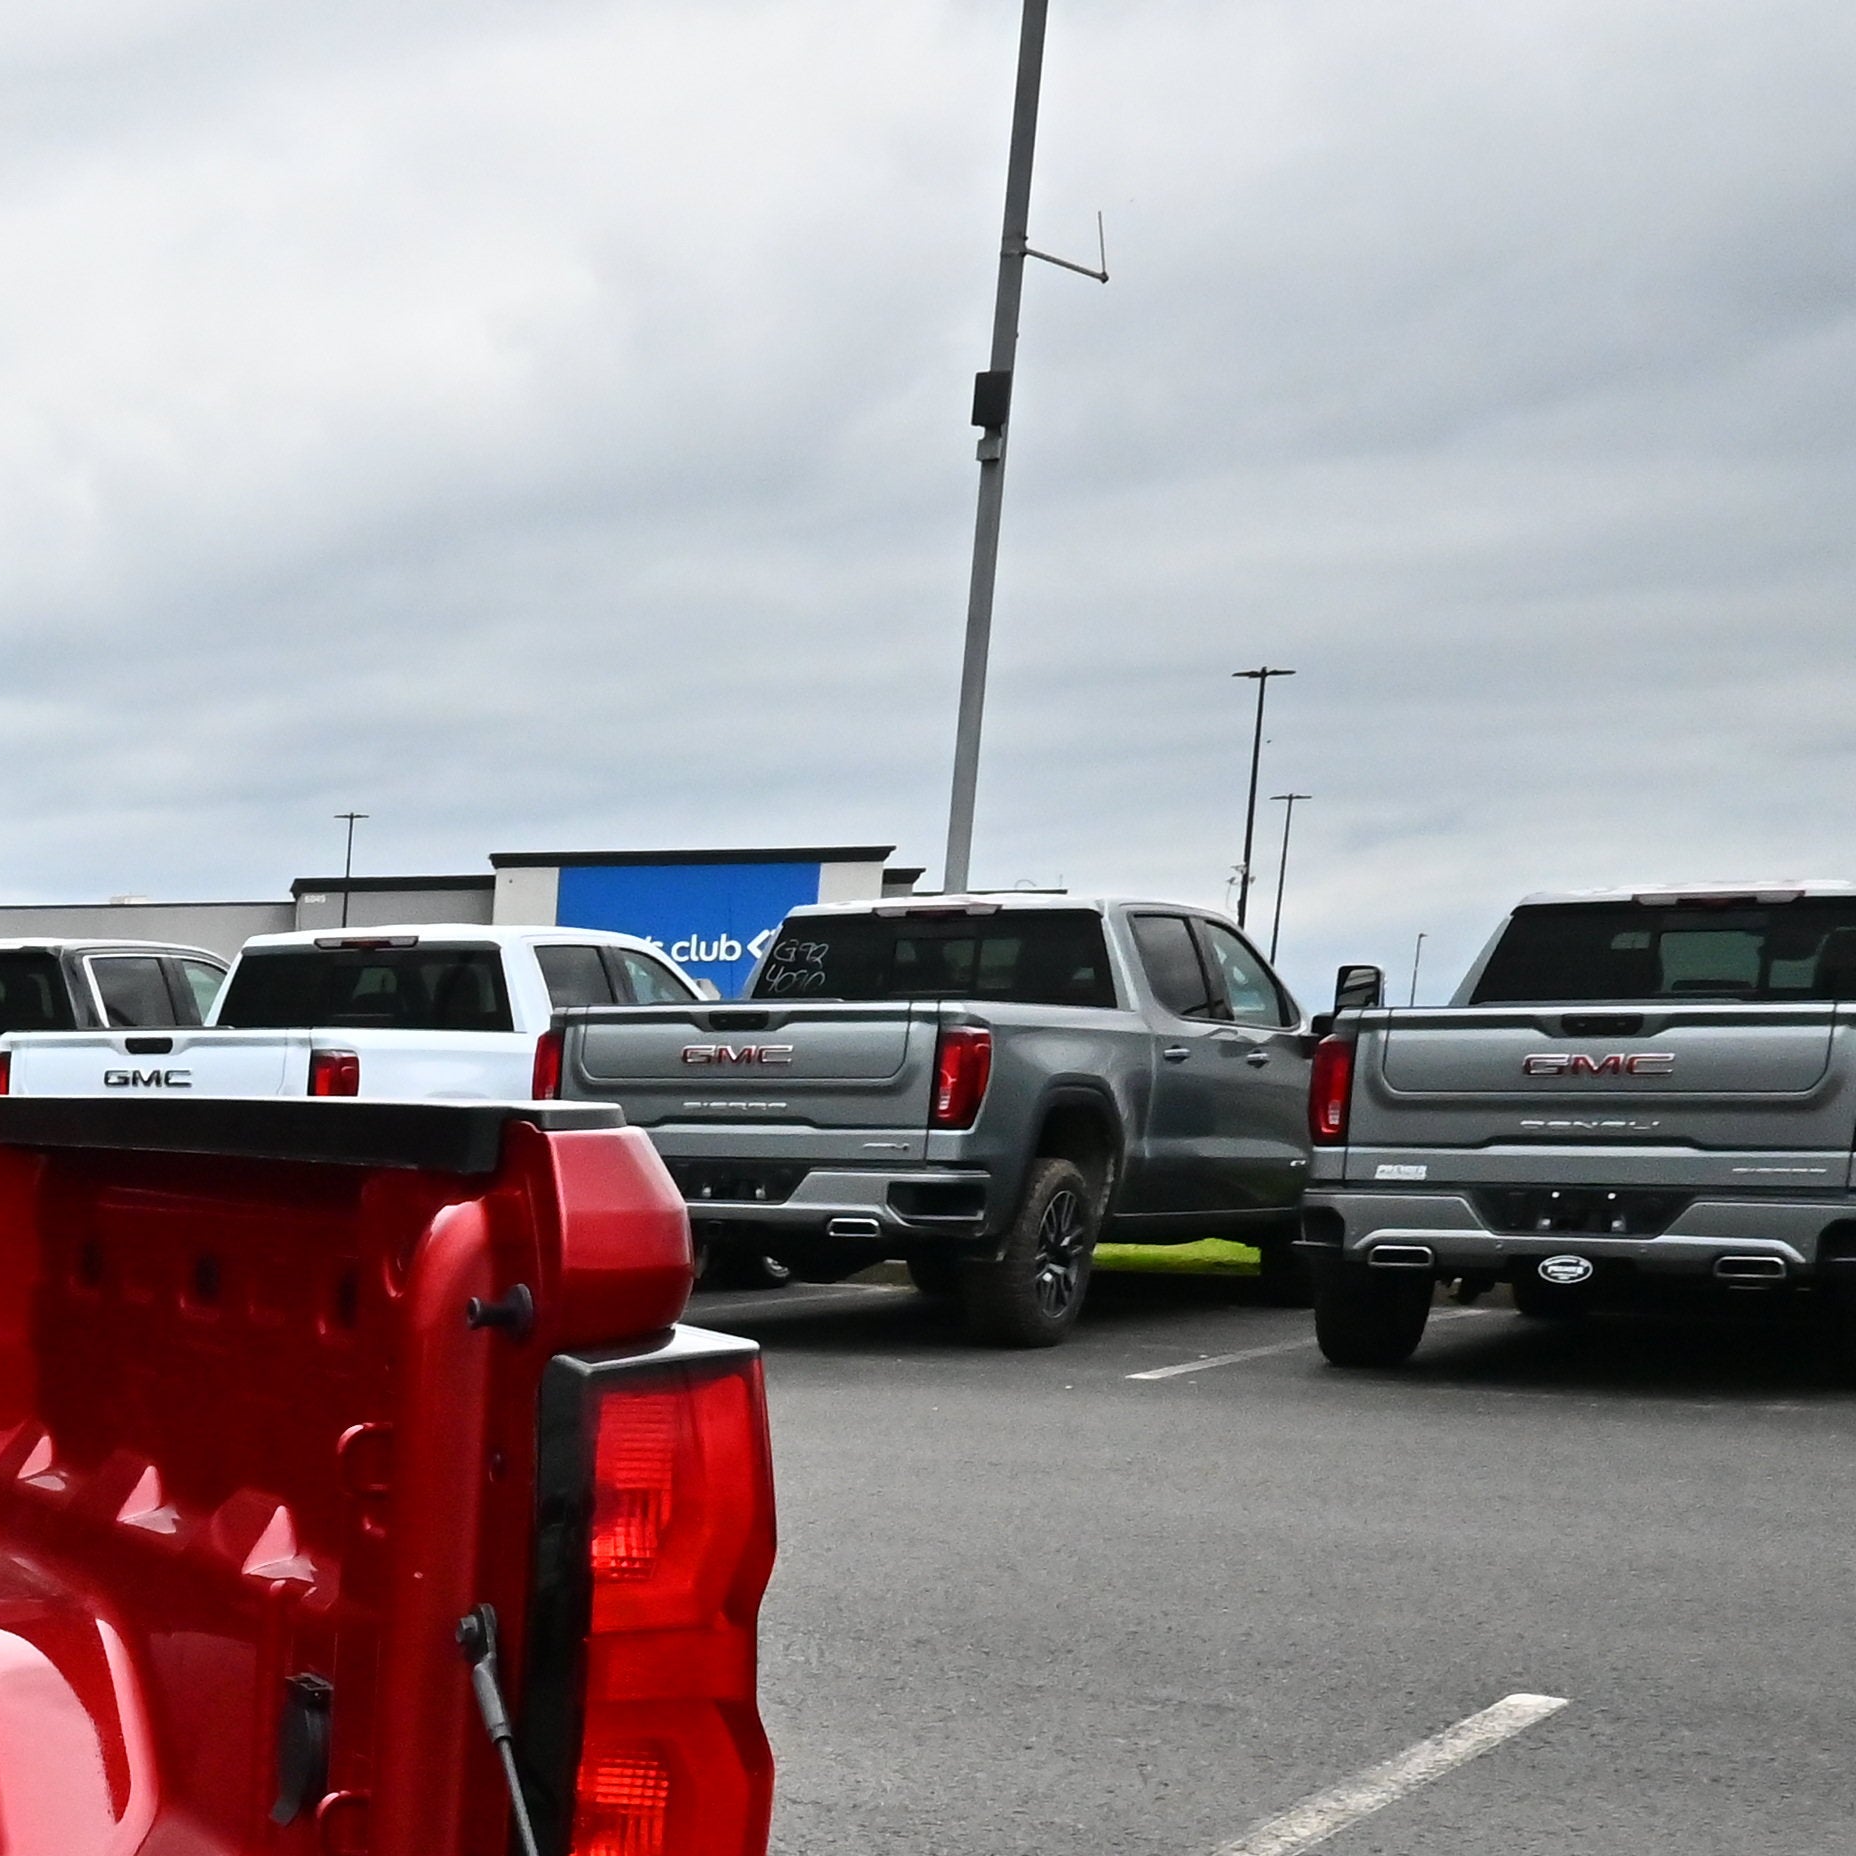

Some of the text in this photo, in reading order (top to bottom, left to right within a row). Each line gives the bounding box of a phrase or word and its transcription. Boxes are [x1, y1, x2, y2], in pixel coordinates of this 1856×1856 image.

[671, 933, 743, 962] club
[681, 1044, 795, 1065] GMC
[1522, 1052, 1676, 1077] GMC
[104, 1069, 192, 1088] GMC
